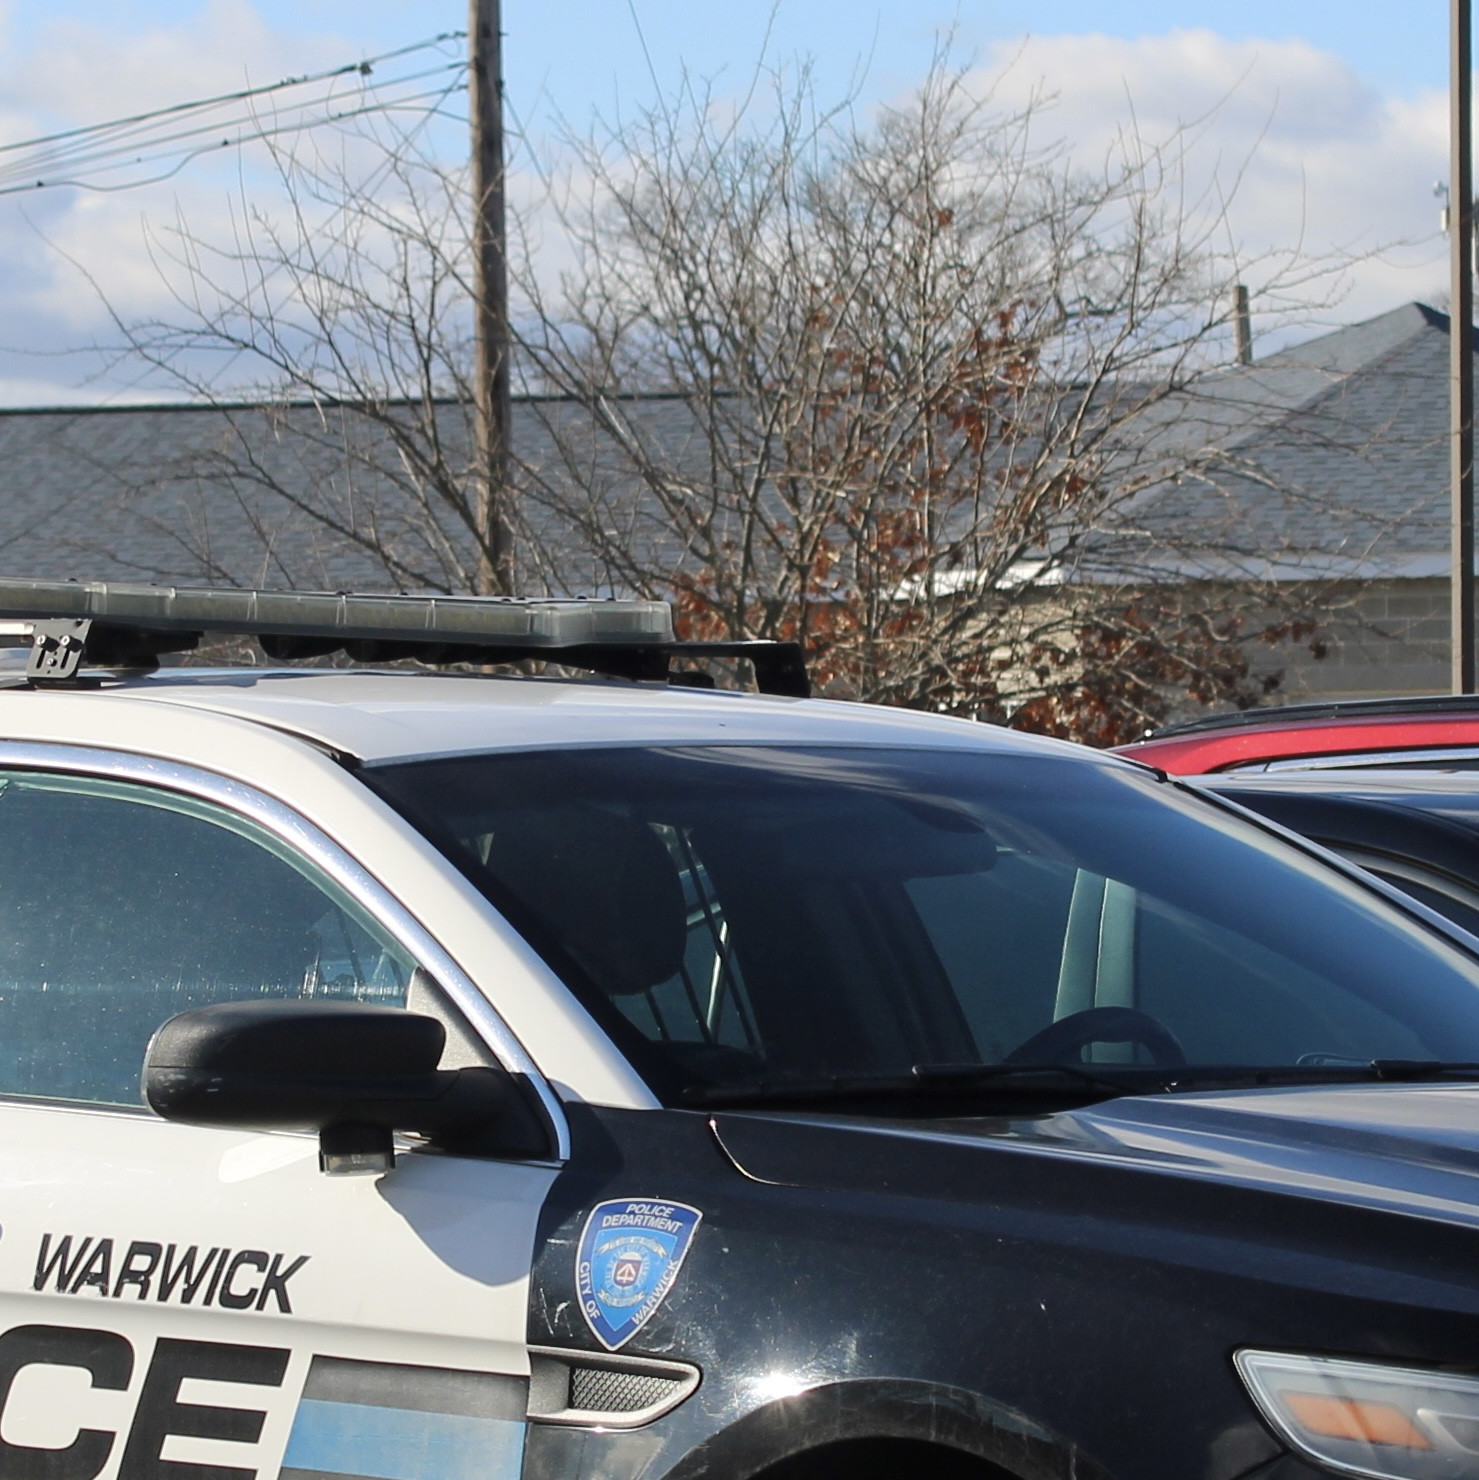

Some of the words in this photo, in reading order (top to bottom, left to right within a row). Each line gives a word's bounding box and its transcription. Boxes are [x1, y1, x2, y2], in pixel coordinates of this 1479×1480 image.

[602, 1215, 683, 1233] DEPARTMENT
[625, 1203, 675, 1218] POLICE
[32, 1233, 312, 1314] WARWICK
[580, 1262, 592, 1296] CITY
[586, 1301, 601, 1320] OF
[632, 1260, 680, 1325] WARWICK
